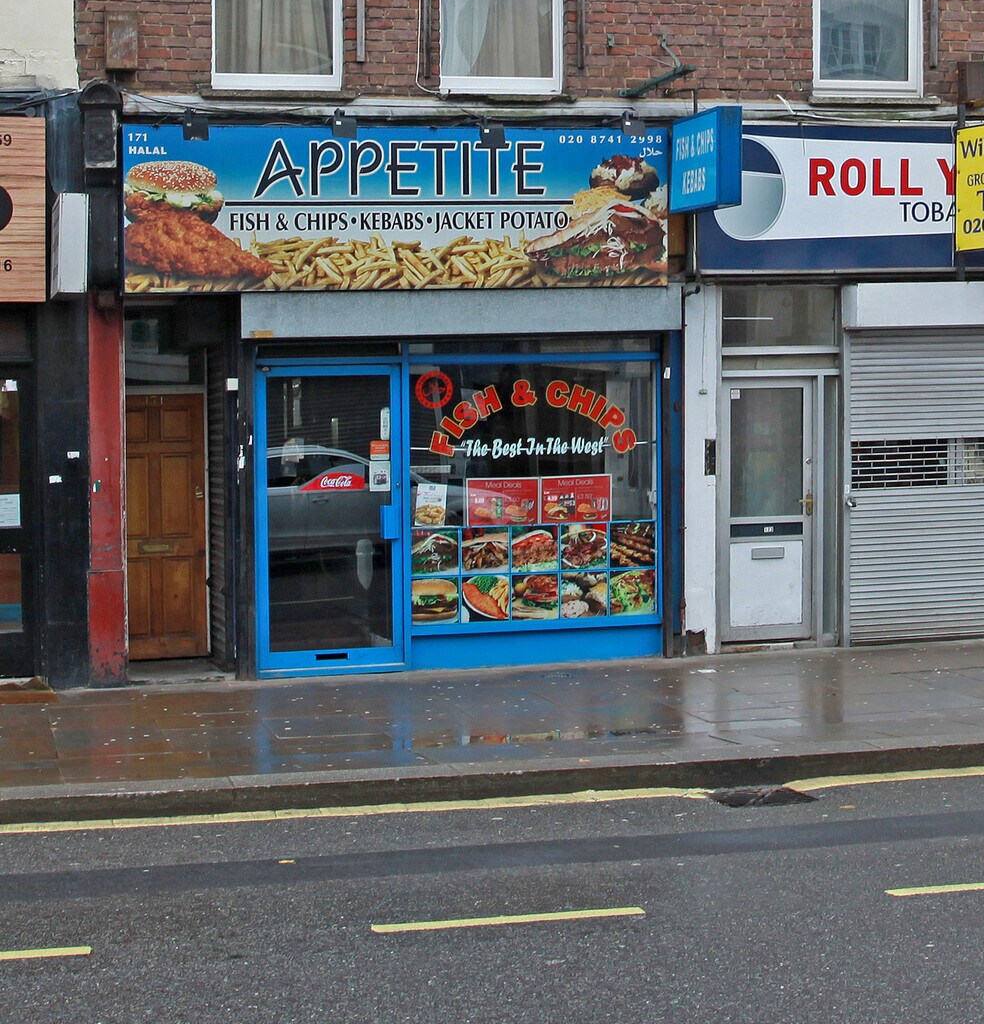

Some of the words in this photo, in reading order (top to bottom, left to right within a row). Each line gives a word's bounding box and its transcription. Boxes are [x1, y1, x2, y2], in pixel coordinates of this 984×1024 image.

[127, 132, 148, 142] 171
[559, 135, 583, 144] 020
[590, 135, 621, 144] 8741
[630, 134, 662, 144] 2998
[676, 136, 690, 162] FISH
[690, 134, 695, 158] &
[696, 128, 714, 156] CHIPS
[128, 145, 167, 155] HALAL
[639, 146, 663, 158] حلال
[253, 138, 545, 197] APPETITE
[809, 158, 923, 196] ROLL
[682, 166, 706, 195] KEBABS
[229, 212, 269, 231] FISH
[275, 212, 288, 231] &
[294, 212, 348, 231] CHIPS
[360, 211, 424, 231] KEBABS
[433, 211, 496, 234] JACKET
[500, 211, 569, 230] POTATO
[429, 384, 502, 457] FISH
[511, 379, 538, 407] &
[546, 380, 637, 454] CHIPS
[492, 438, 522, 459] Best
[545, 436, 569, 455] The
[485, 481, 502, 489] Meal
[503, 480, 522, 489] Deals
[557, 479, 575, 487] Meal
